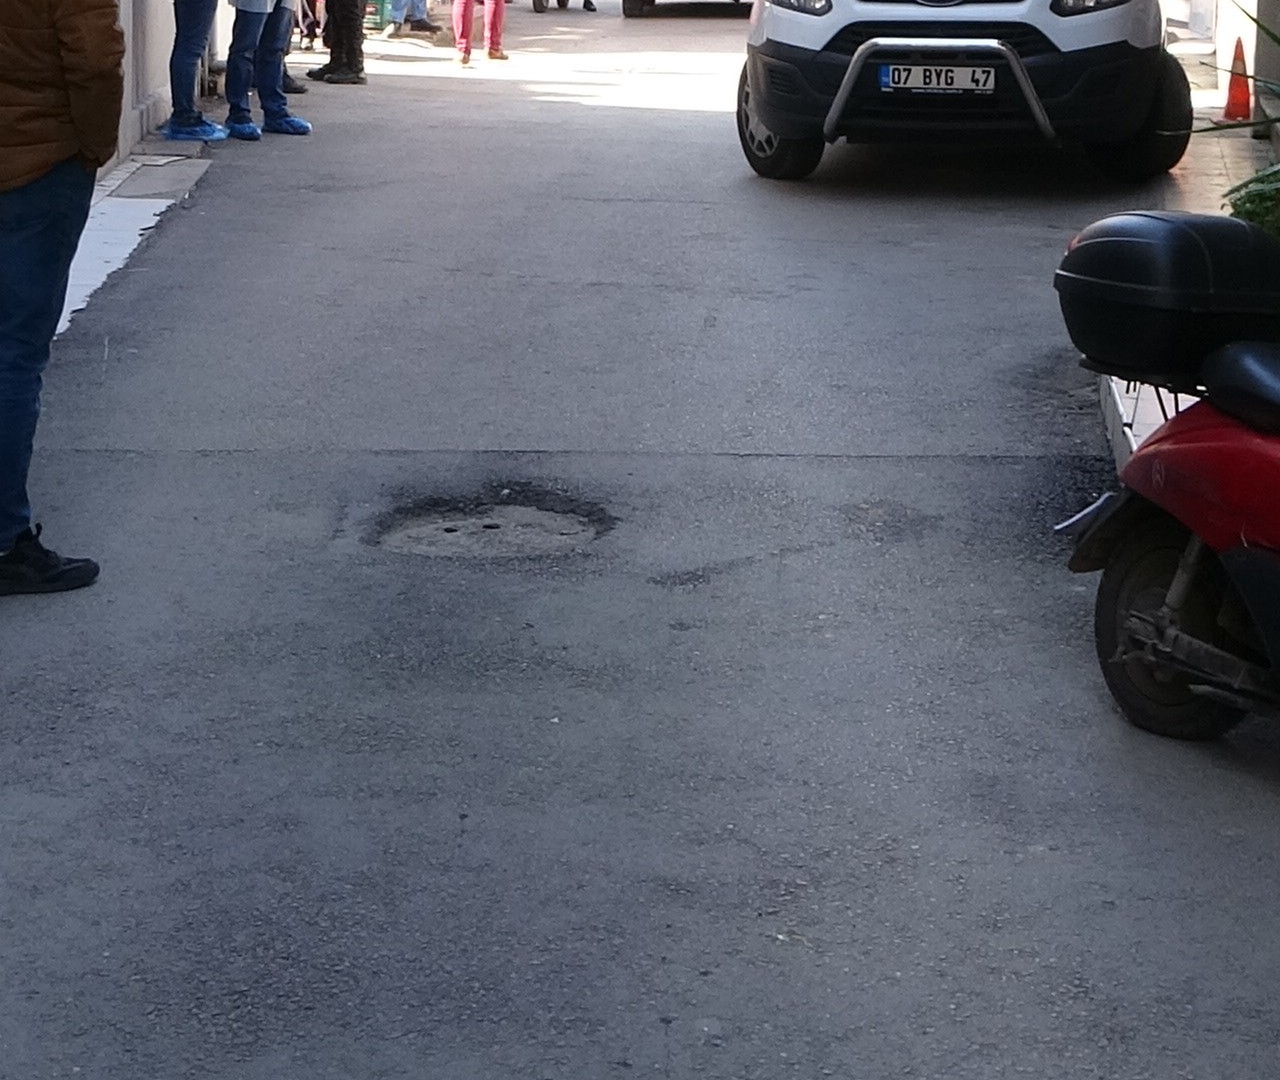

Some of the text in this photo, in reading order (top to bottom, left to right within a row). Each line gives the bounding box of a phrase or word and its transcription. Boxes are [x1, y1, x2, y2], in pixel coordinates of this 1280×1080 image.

[891, 67, 992, 88] 07 BYG 47
